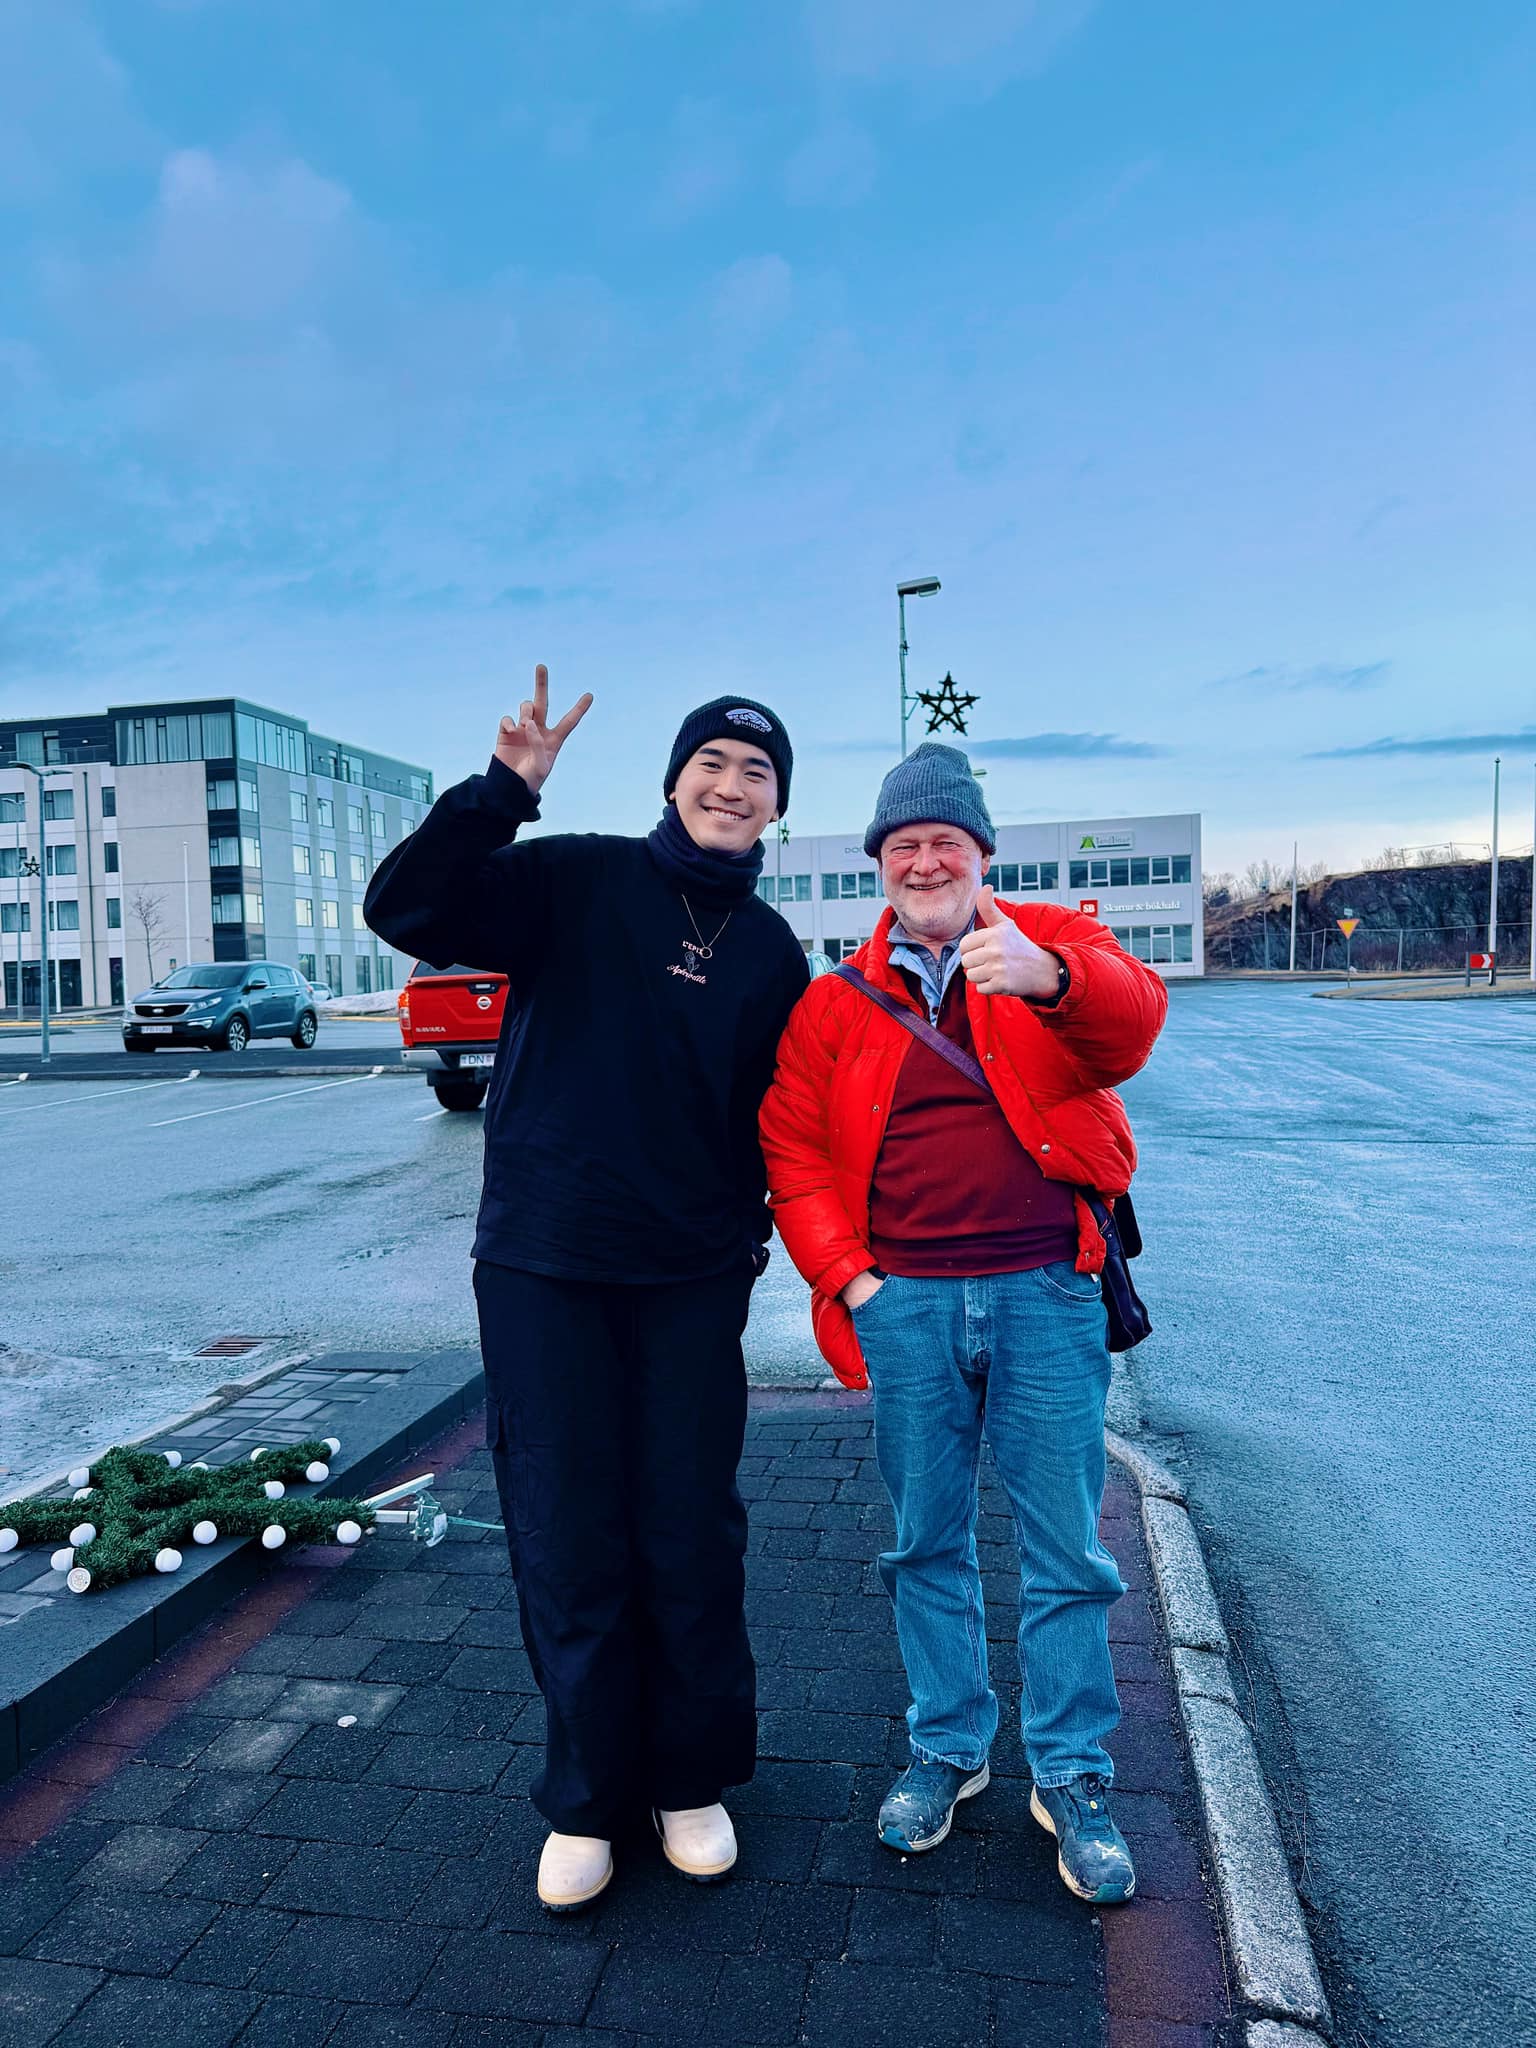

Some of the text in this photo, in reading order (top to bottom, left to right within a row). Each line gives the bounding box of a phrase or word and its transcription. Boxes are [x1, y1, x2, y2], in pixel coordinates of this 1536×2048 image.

[1083, 904, 1095, 912] SB
[1135, 903, 1144, 911] &
[468, 1055, 485, 1064] DN
